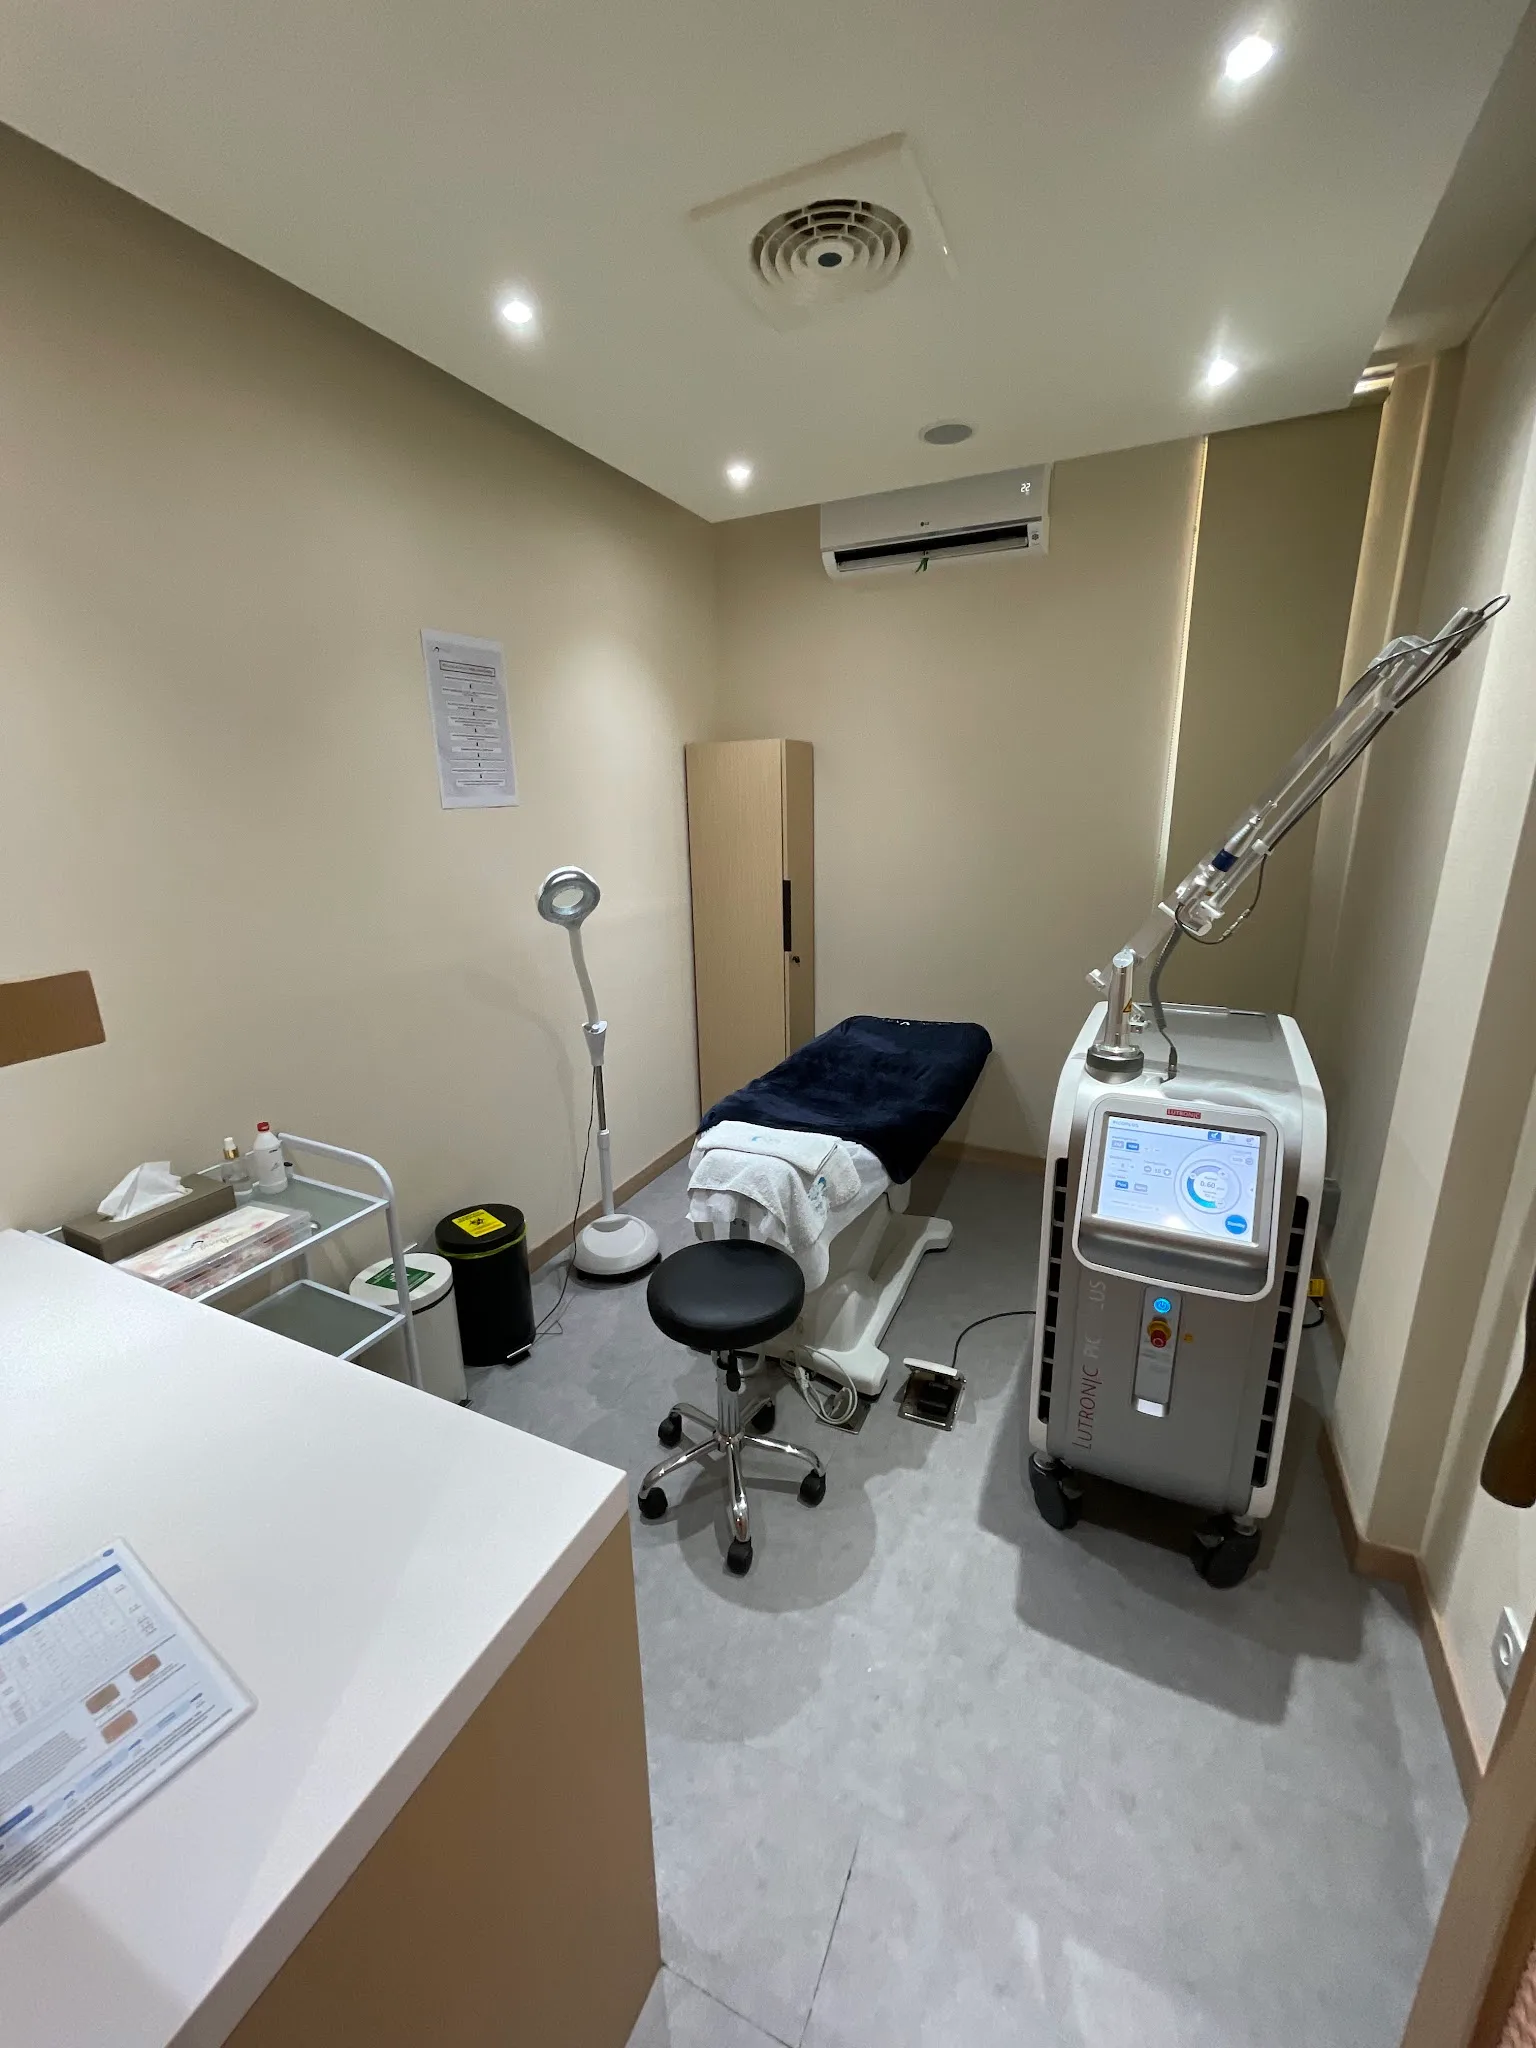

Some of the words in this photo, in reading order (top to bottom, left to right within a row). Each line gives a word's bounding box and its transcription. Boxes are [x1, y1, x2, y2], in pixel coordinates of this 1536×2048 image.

[1021, 482, 1031, 493] 22
[1167, 1109, 1201, 1119] LUTRONIC
[1200, 1180, 1216, 1189] 0.60
[1071, 1364, 1103, 1450] LUTRONIC
